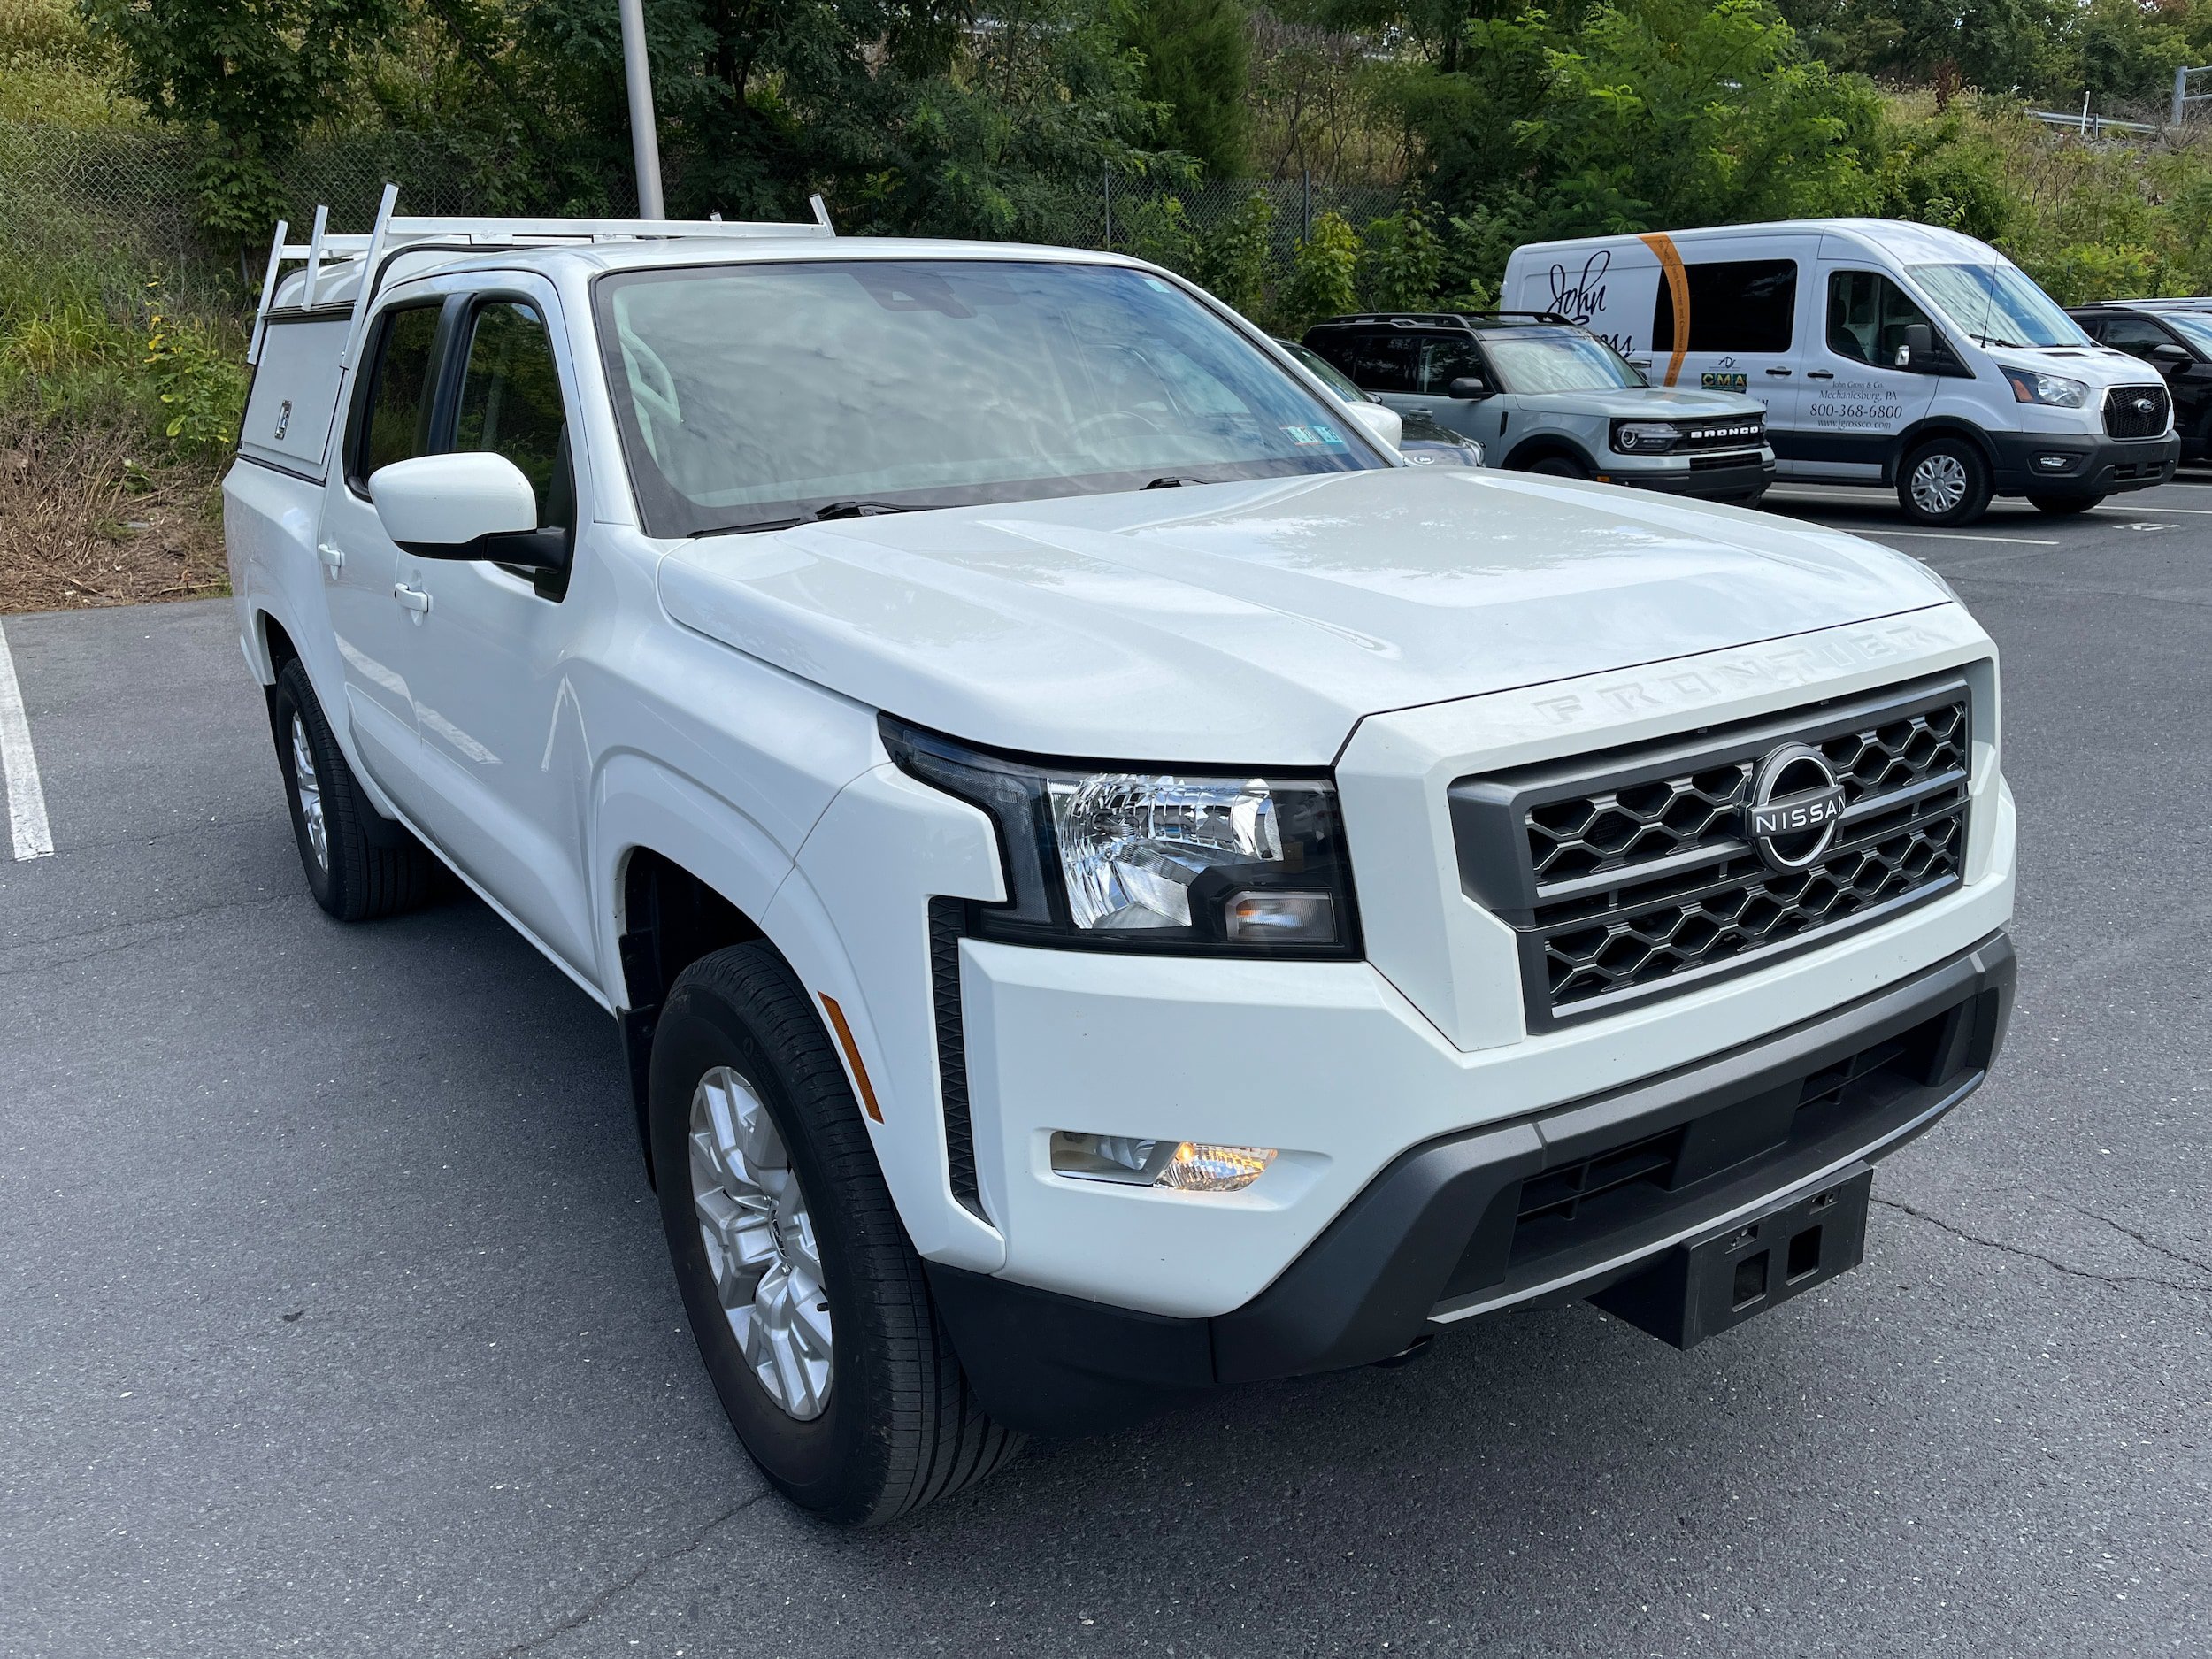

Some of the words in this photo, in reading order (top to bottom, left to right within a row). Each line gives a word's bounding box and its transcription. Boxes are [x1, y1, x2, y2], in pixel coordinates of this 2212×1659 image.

[1547, 250, 1611, 317] John
[1702, 373, 1745, 387] CMA
[1886, 391, 1898, 401] PA
[1810, 403, 1903, 419] 800-368-6800
[1817, 419, 1892, 430] www.jgrossco.com
[1691, 426, 1759, 439] BRONCO
[1531, 626, 1955, 723] FRONTIER
[1756, 795, 1846, 833] NISSAN
